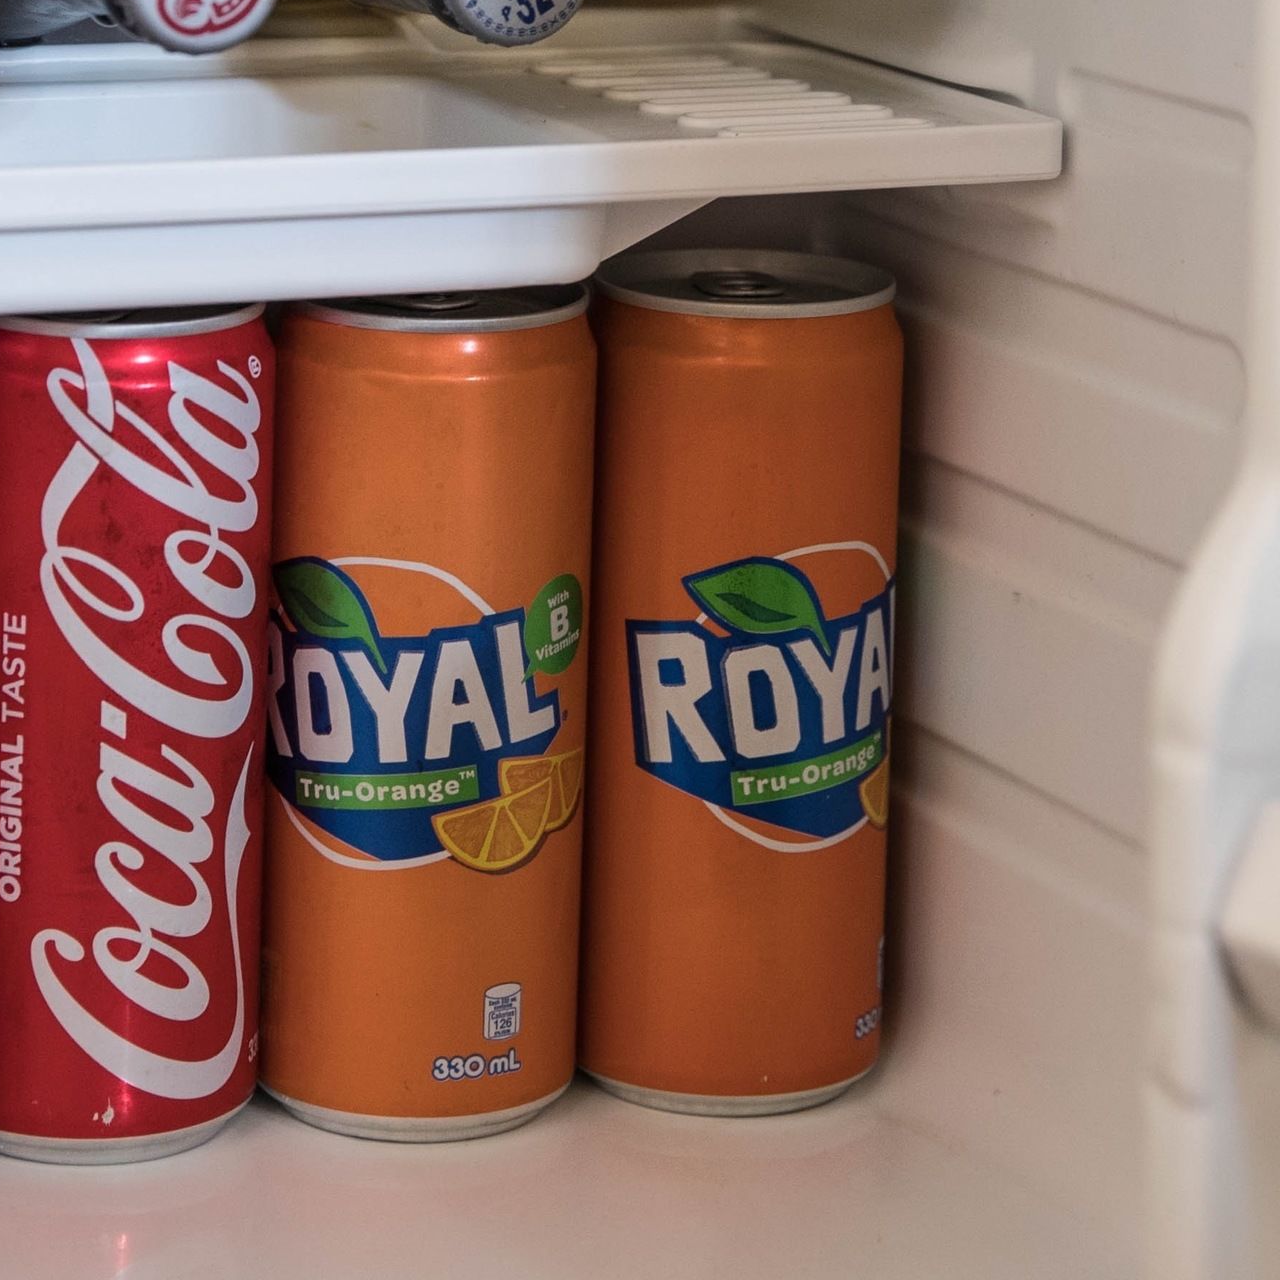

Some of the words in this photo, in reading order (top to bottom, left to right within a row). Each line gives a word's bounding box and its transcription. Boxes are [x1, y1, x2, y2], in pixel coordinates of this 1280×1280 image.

[547, 589, 570, 609] With
[549, 604, 570, 642] B
[535, 628, 581, 662] Vitamins
[0, 612, 27, 723] TASTE
[31, 338, 262, 1100] Coca-Cola
[494, 1018, 512, 1030] 126
[432, 1053, 486, 1081] 330
[488, 1046, 522, 1076] mL
